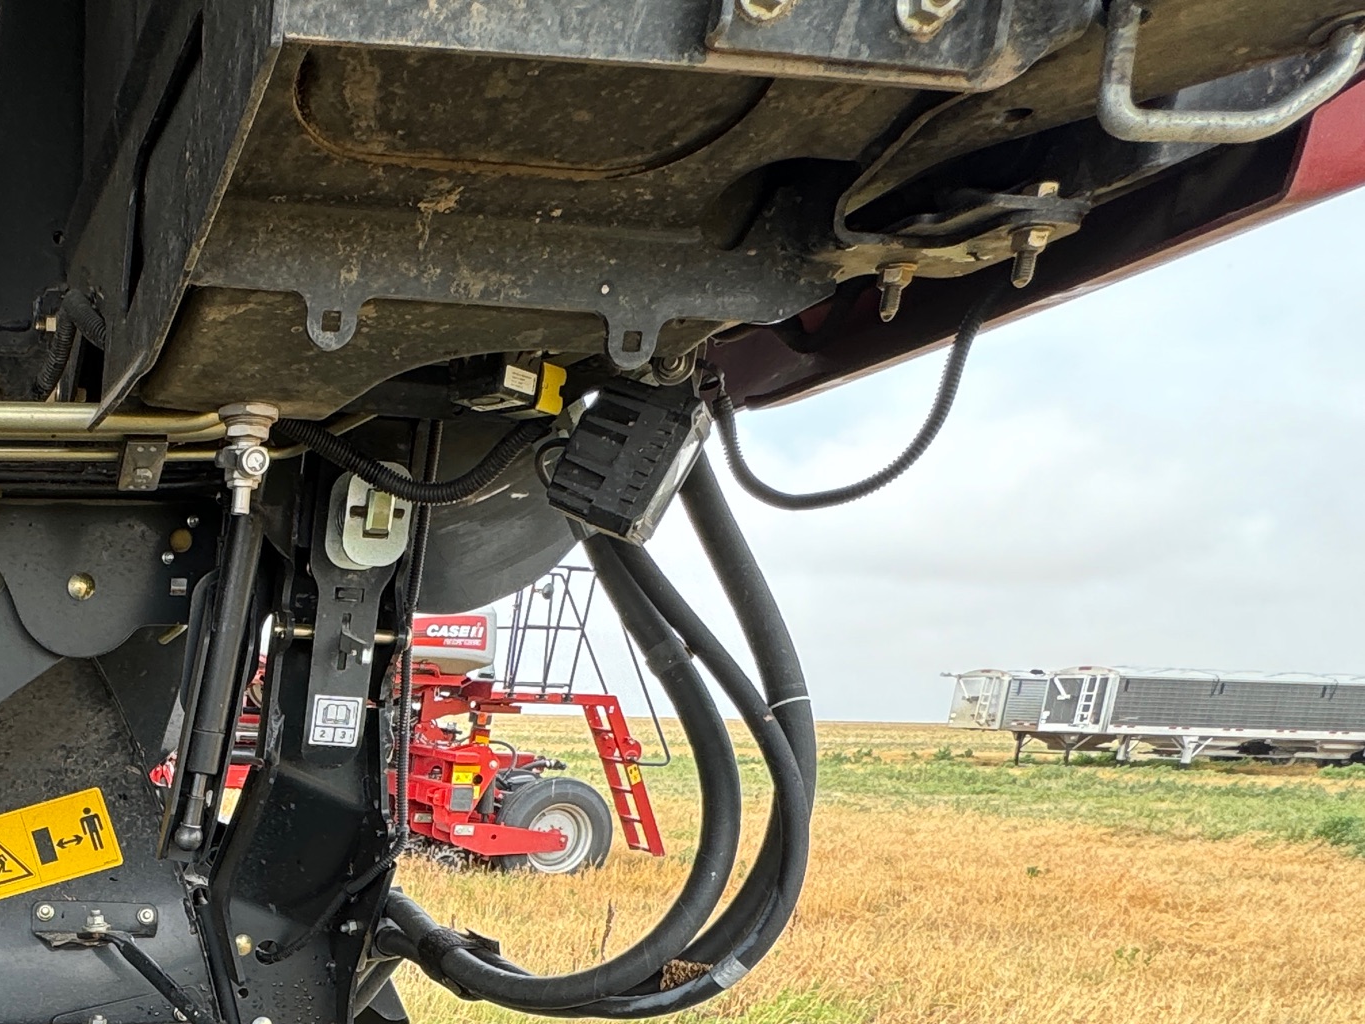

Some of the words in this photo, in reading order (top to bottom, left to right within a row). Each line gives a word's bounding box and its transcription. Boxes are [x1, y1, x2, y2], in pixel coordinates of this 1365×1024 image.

[426, 624, 471, 638] CASE
[319, 729, 326, 739] 2
[339, 730, 347, 740] 3
